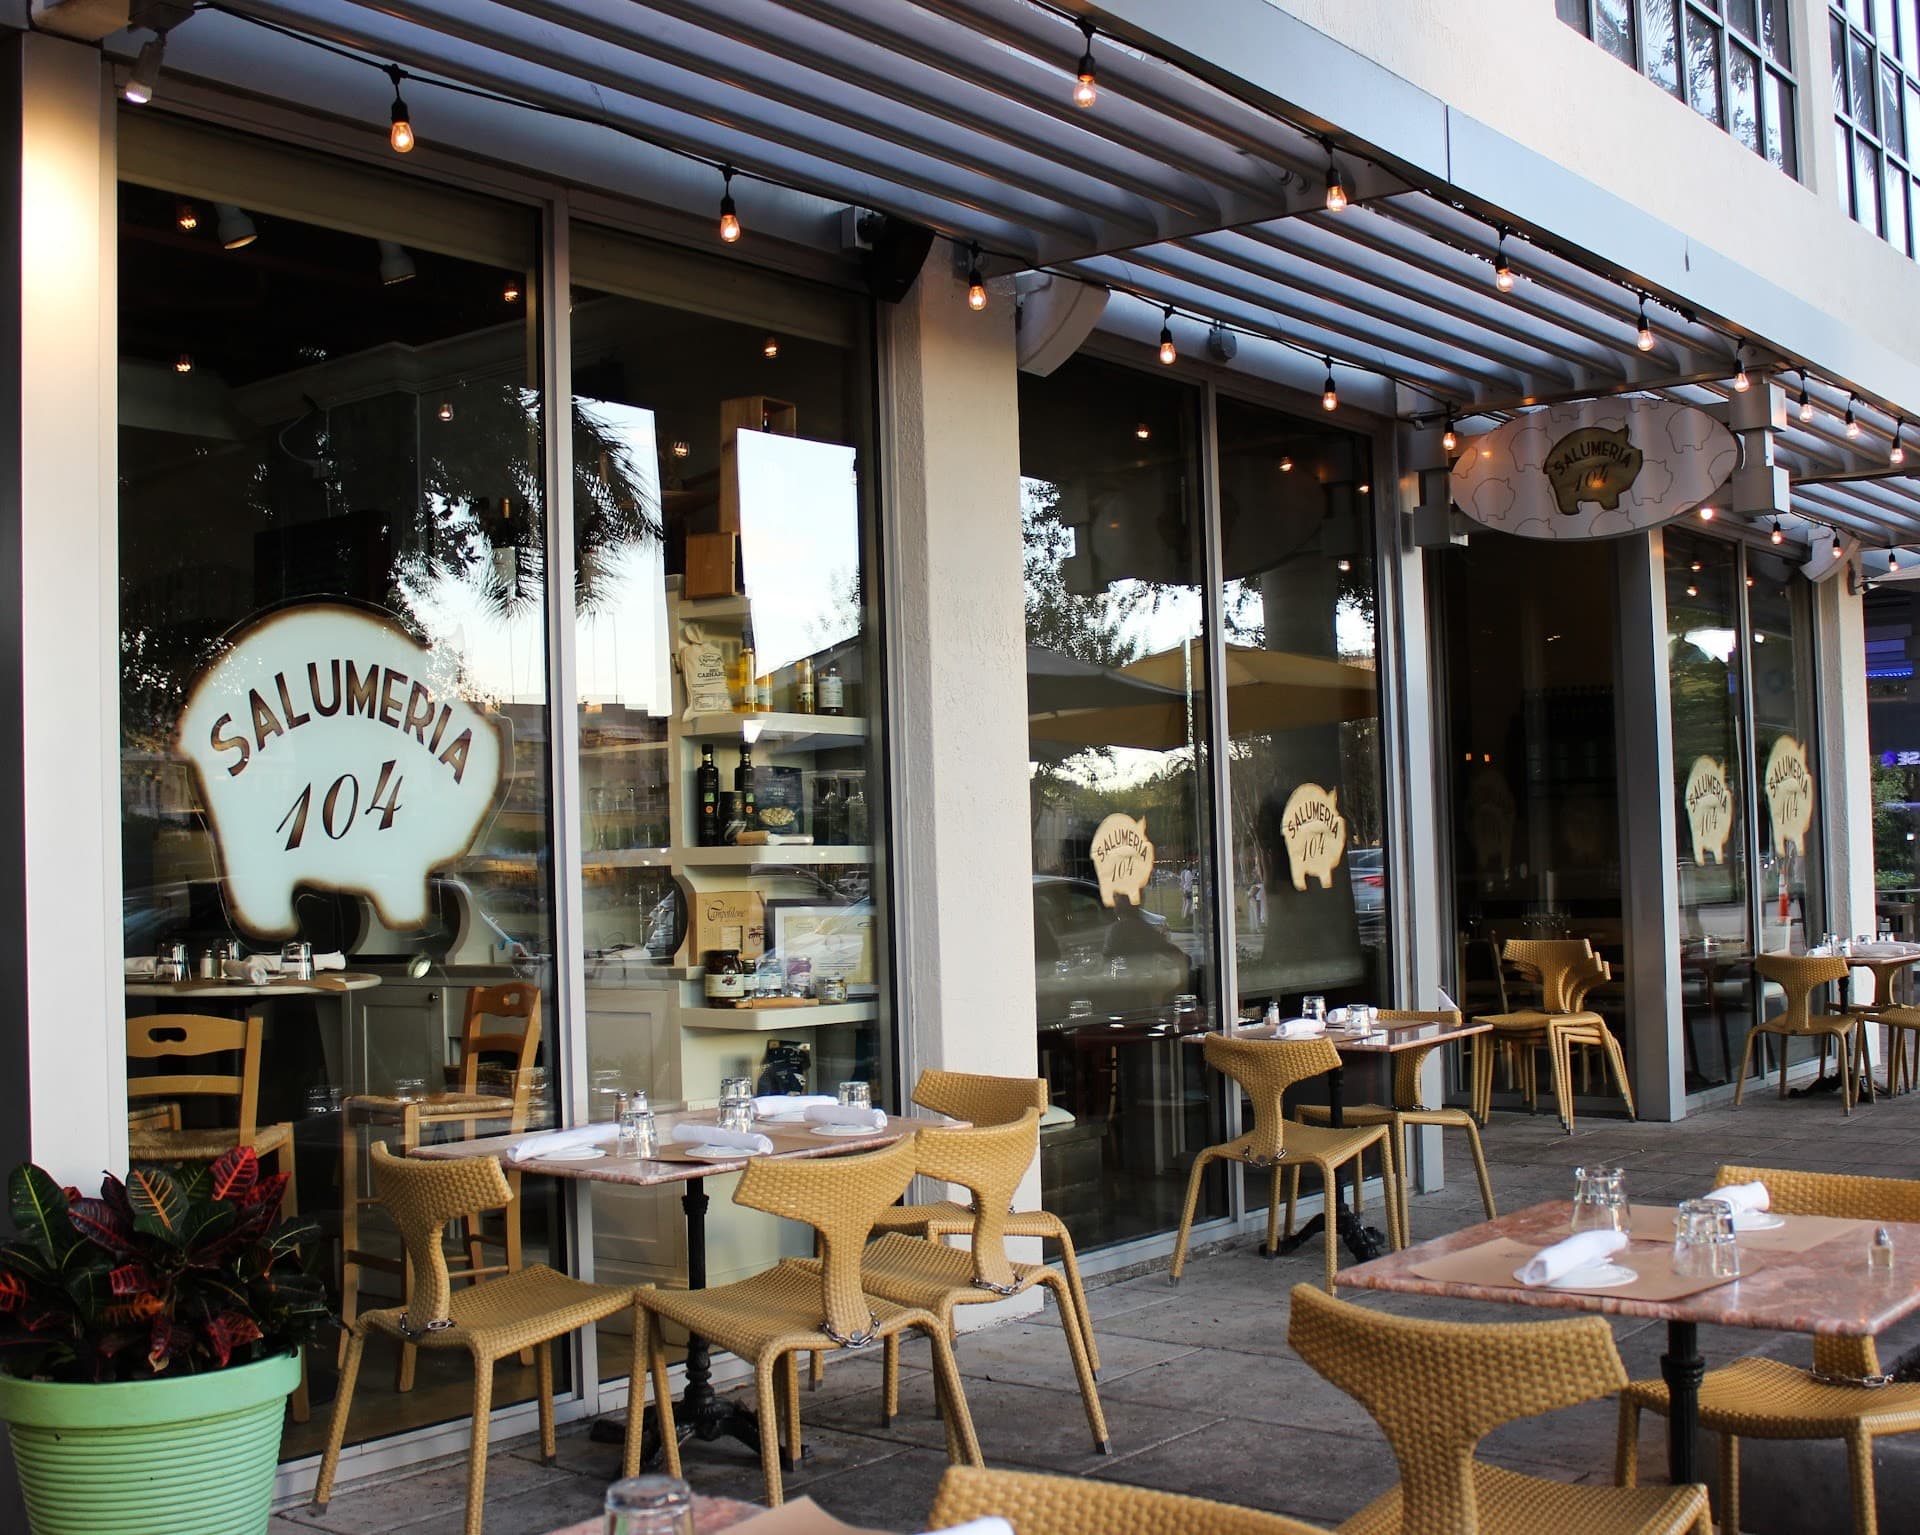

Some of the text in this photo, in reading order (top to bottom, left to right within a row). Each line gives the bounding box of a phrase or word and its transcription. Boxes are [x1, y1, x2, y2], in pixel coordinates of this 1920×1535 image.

[1553, 440, 1633, 476] SALUMERIA
[1574, 462, 1609, 493] 104
[210, 659, 473, 785] SALUMERIA
[1689, 773, 1728, 813] SALUMERIA
[1768, 755, 1808, 799] SALUMERIA
[276, 760, 404, 852] 104
[1287, 801, 1339, 839] SALUMERIA
[1700, 806, 1718, 837] 104
[1781, 791, 1799, 825] 104
[1096, 828, 1148, 863] SALUMERIA
[1302, 832, 1325, 862] 104
[1111, 856, 1135, 883] 104
